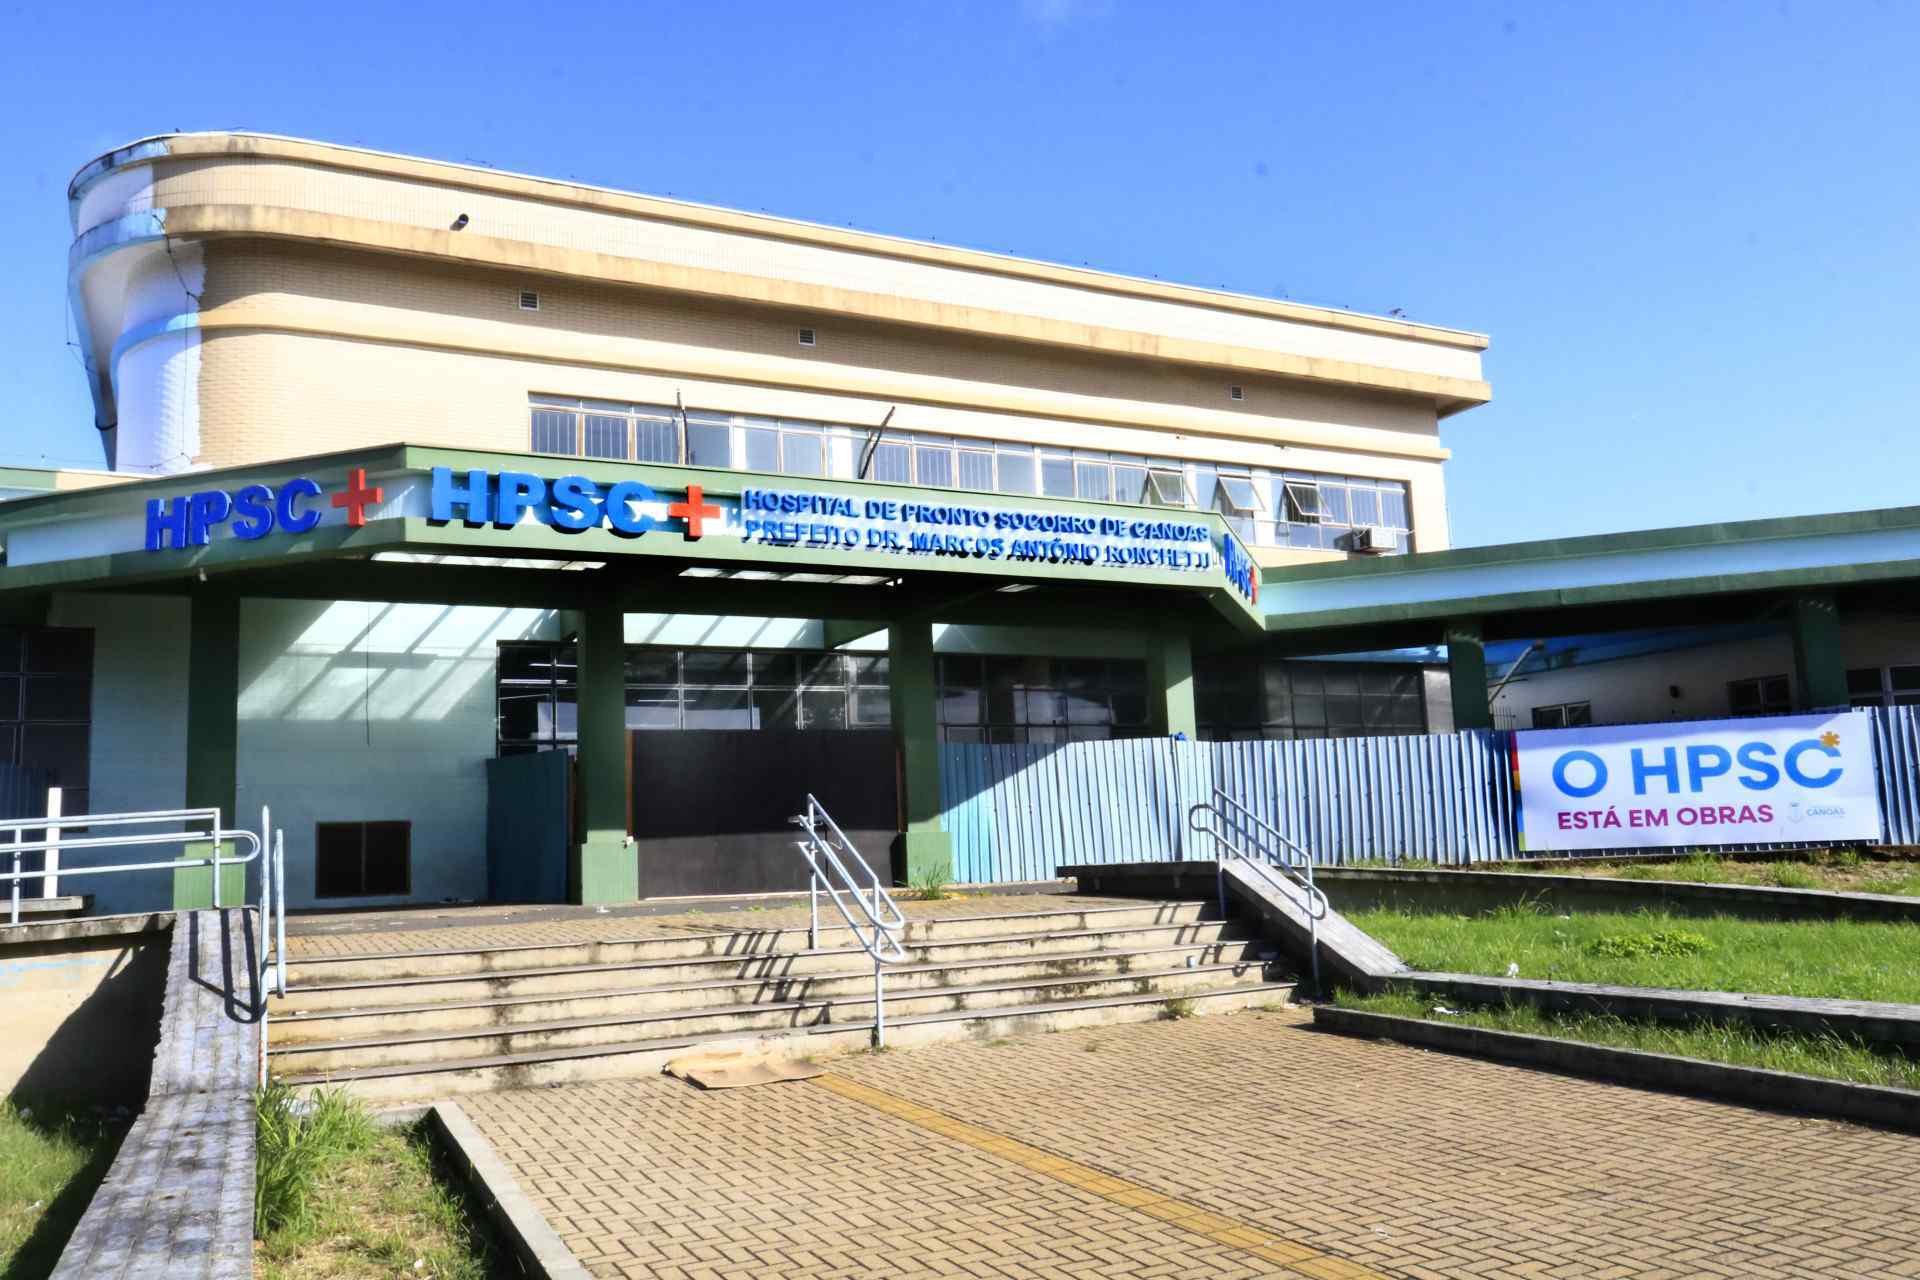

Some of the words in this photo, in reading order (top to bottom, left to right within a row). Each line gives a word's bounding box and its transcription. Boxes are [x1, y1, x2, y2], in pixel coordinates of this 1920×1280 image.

[145, 477, 323, 551] HPSC
[431, 466, 656, 534] HPSC
[743, 490, 861, 519] HOSPITAL
[865, 500, 897, 521] DE
[900, 503, 990, 528] PRONTO
[993, 511, 1097, 535] SOCORRO
[1099, 516, 1128, 537] DE
[1129, 521, 1211, 543] CANOAS
[743, 519, 860, 547] PREFEITO
[866, 528, 905, 550] DR.
[908, 532, 1004, 559] MARCOS
[1008, 536, 1100, 565] ANTÔNIO
[1104, 544, 1209, 570] RONCHETTI
[1552, 750, 1608, 798] O
[1631, 739, 1843, 794] HPSC
[1558, 805, 1622, 830] ESTÁ
[1629, 808, 1669, 828] EM
[1677, 804, 1774, 827] OBRAS
[1806, 807, 1846, 818] CANOAS
